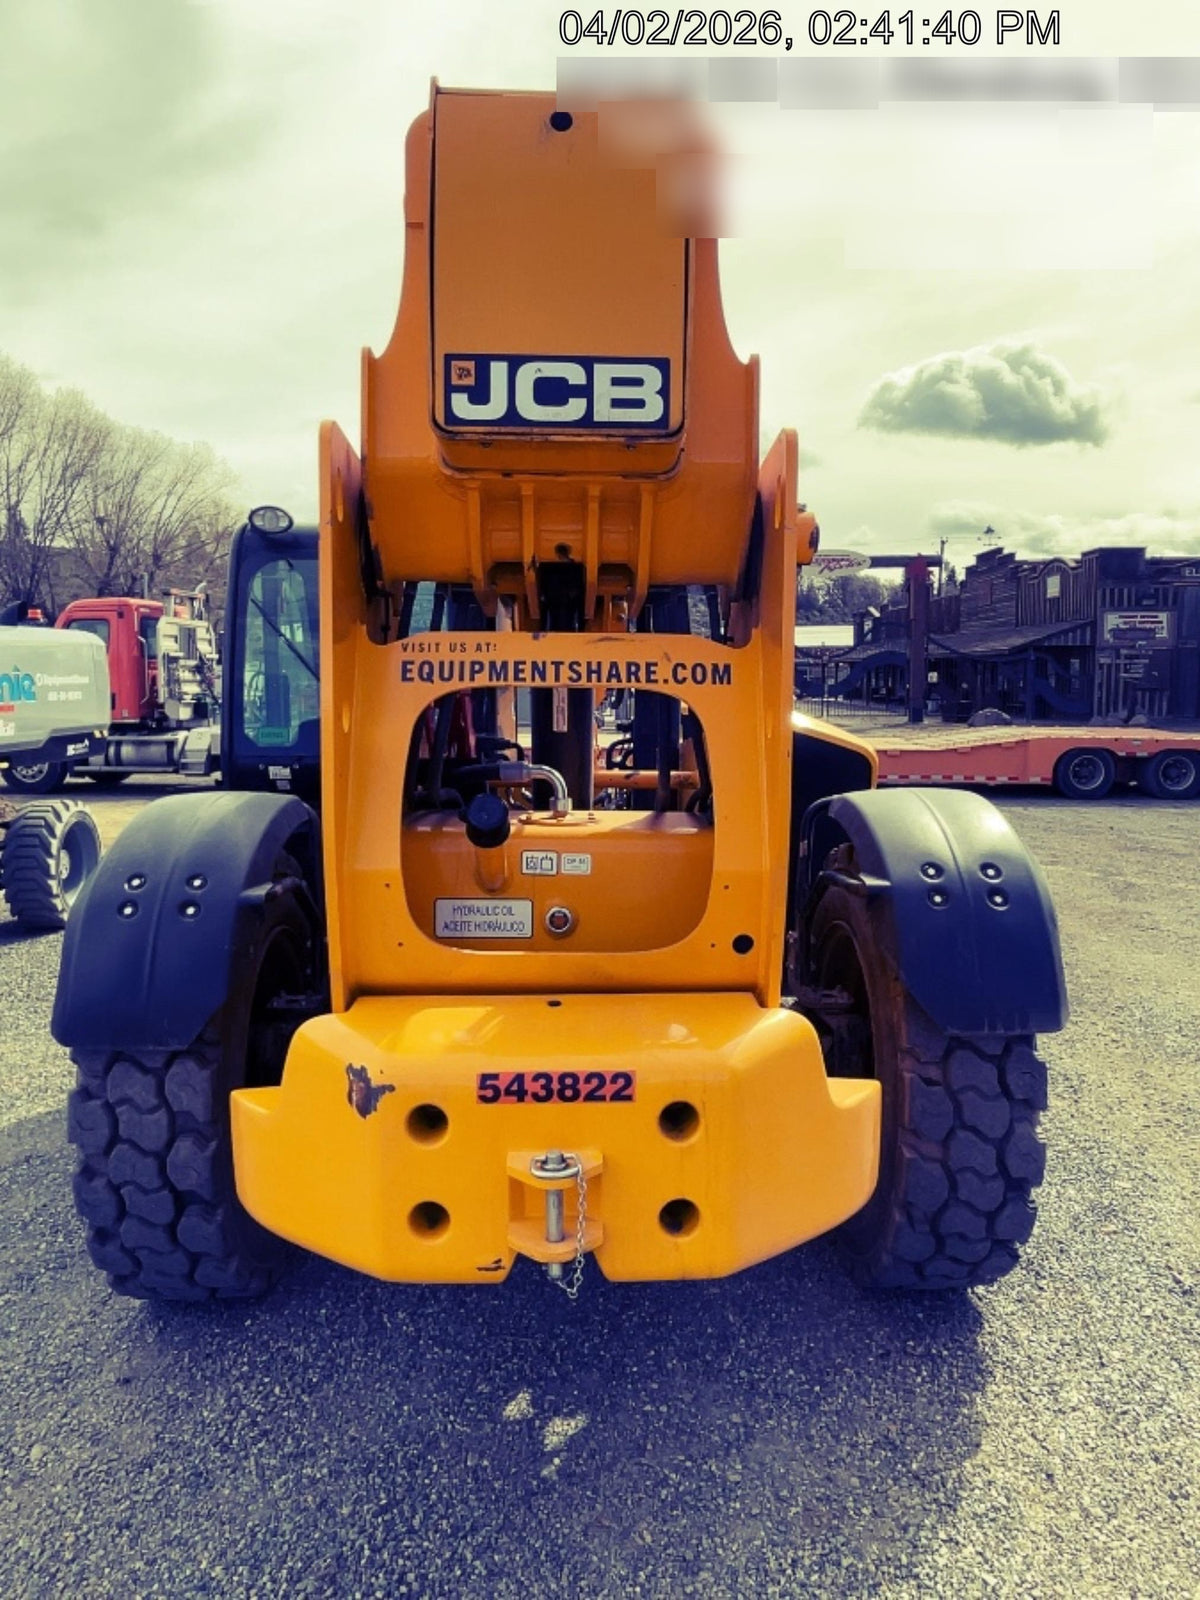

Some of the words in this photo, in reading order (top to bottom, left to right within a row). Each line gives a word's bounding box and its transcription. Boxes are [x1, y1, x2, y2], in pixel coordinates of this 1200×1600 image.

[451, 360, 664, 423] JCB
[401, 642, 441, 653] VISIT
[449, 642, 467, 653] US
[475, 642, 497, 653] AT:
[401, 660, 731, 685] EQUIPMENTSHARE.COM
[452, 904, 500, 916] HYDRAULIC
[501, 905, 516, 916] OIL
[442, 920, 473, 932] ACEITE
[474, 918, 525, 932] HIDRÁULICO
[477, 1072, 634, 1104] 543822
